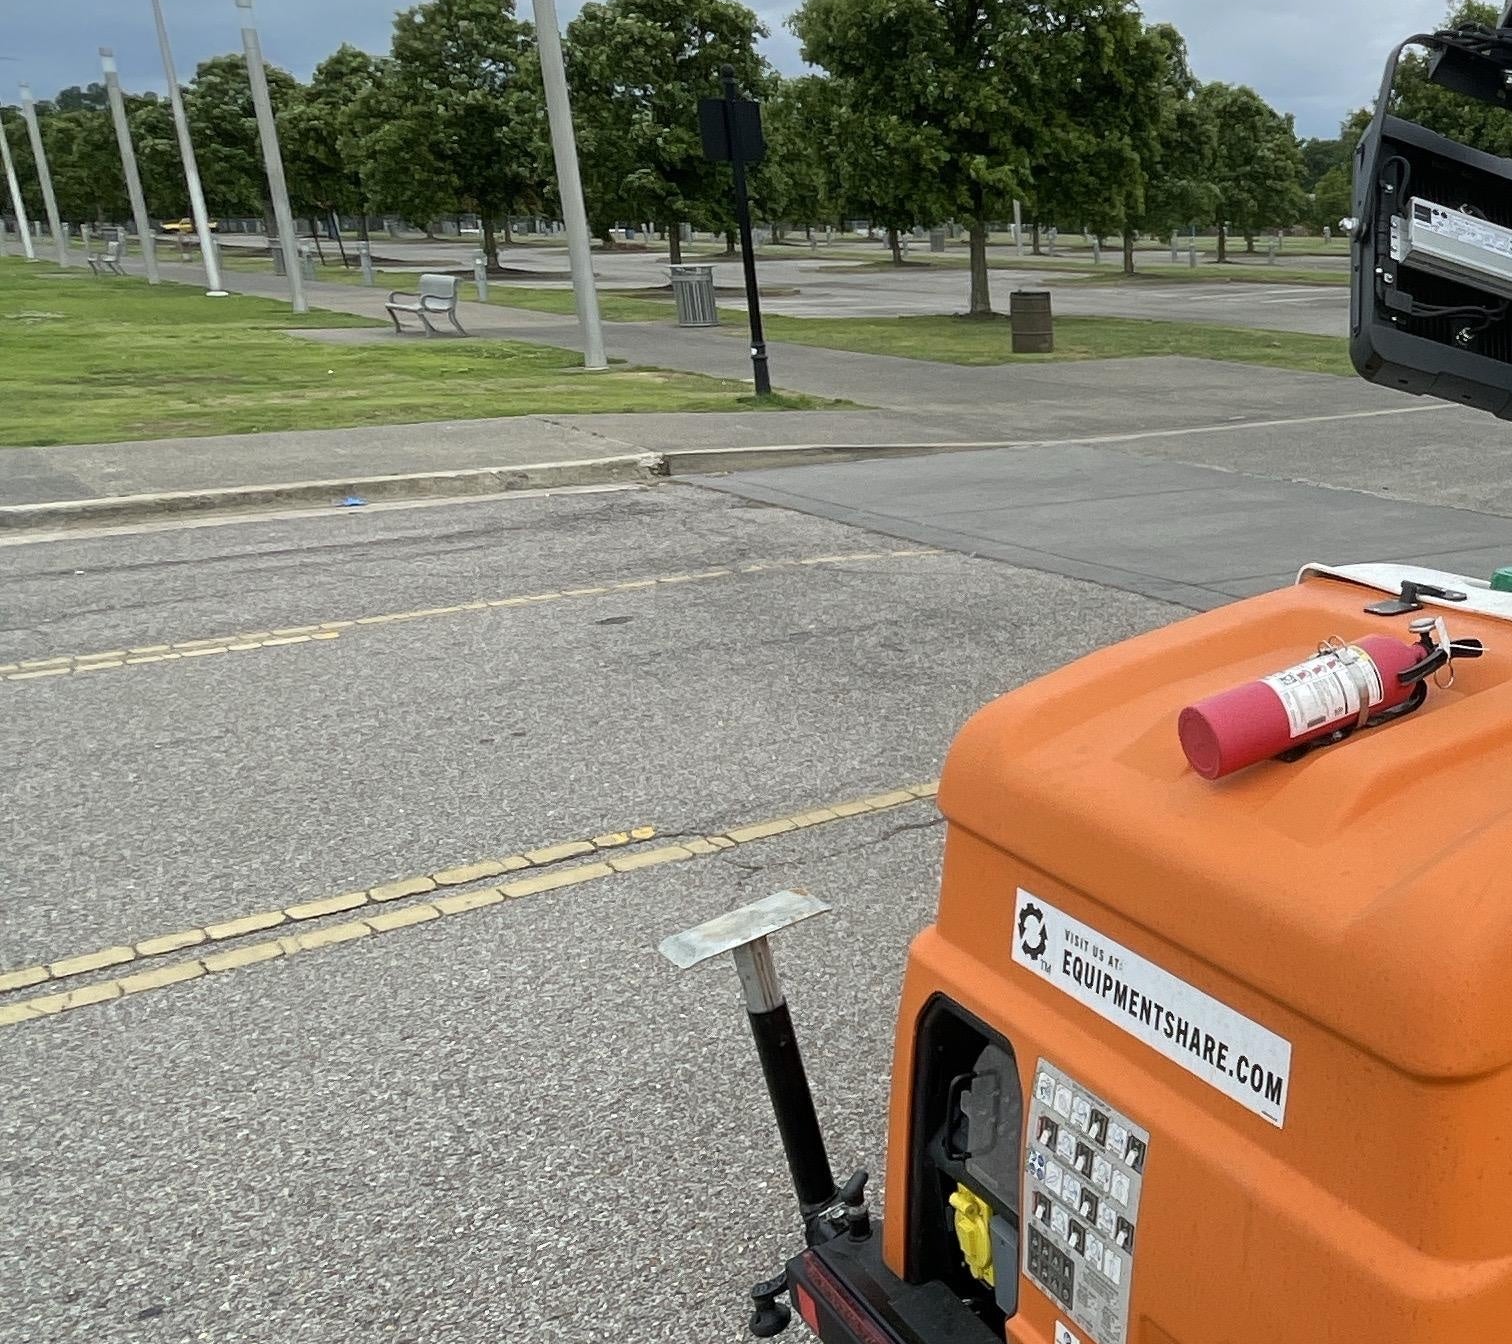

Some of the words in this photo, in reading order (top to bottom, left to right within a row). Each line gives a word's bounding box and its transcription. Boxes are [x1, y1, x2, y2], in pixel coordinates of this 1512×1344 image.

[1065, 928, 1089, 953] VISIT
[1092, 944, 1105, 962] US
[1062, 949, 1284, 1107] EQUIPMENTSHARE.COM
